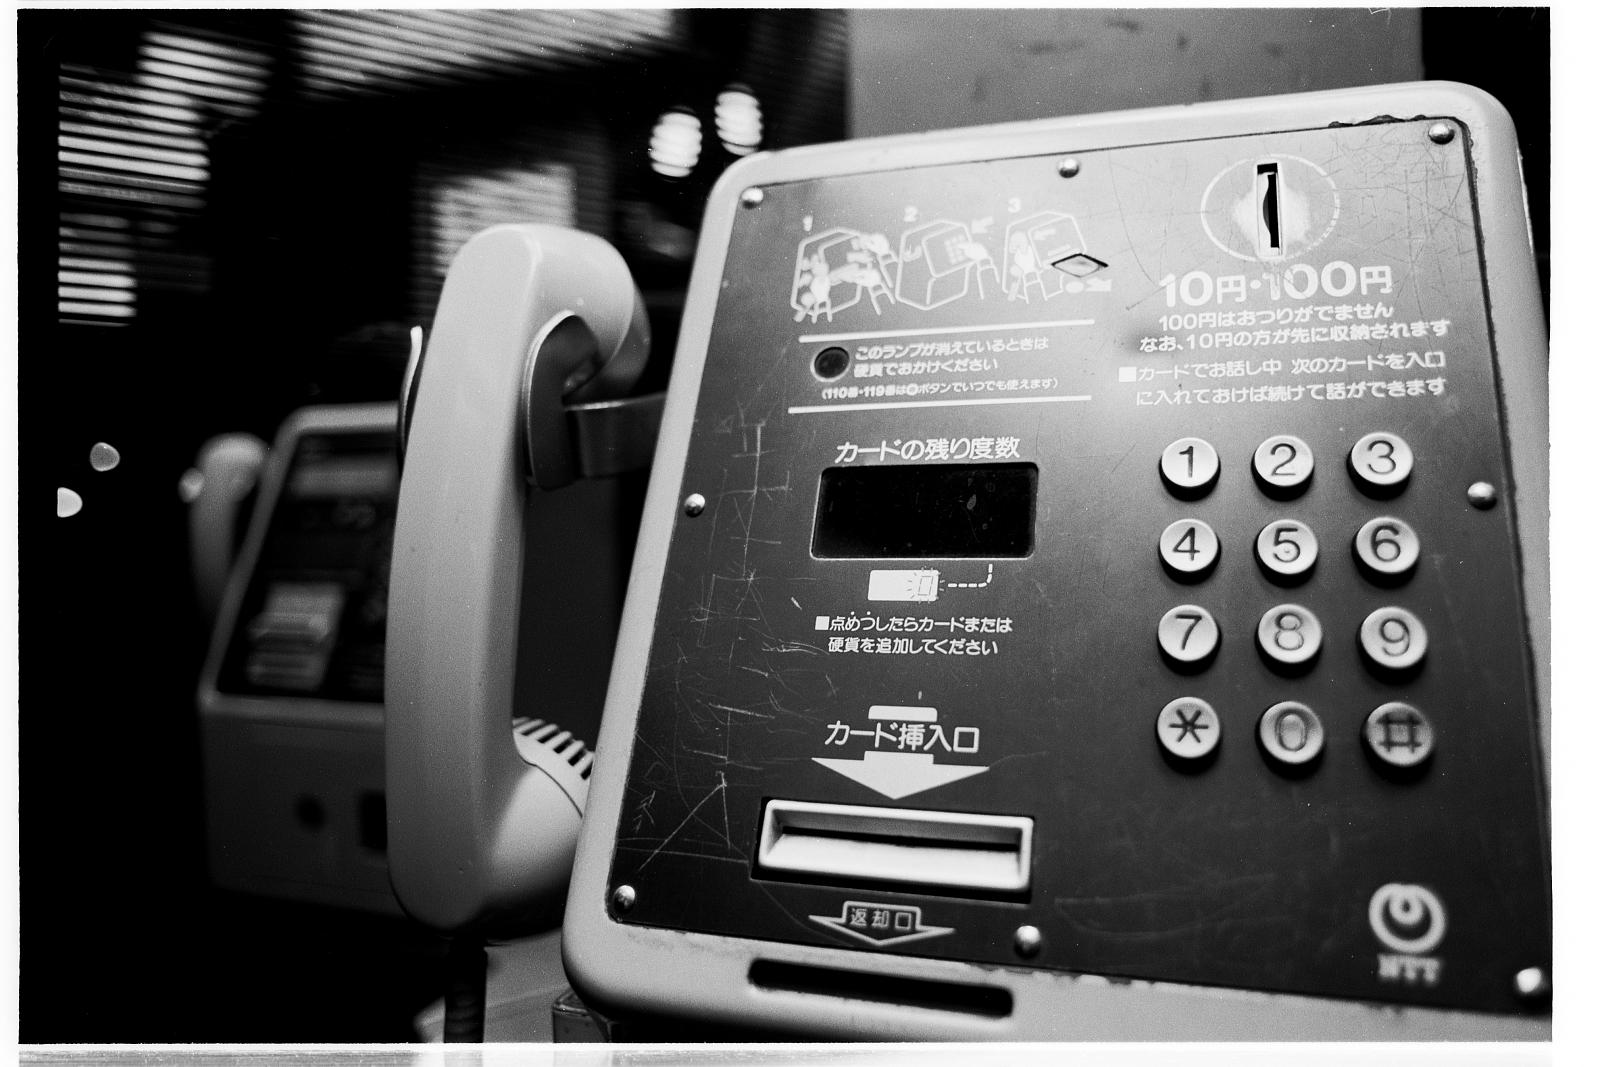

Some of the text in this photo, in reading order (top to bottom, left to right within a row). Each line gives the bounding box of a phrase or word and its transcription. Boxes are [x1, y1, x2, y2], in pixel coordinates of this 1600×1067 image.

[903, 206, 918, 221] 2
[1007, 197, 1021, 213] 3
[1159, 302, 1394, 331] 100円はおつりがでません
[1140, 319, 1451, 353] なお、10円の方が先に収納されます
[1139, 351, 1446, 382] カードでお話し中 次のカードを入口
[1136, 377, 1447, 406] に入れておけば続けて話ができます
[834, 436, 1021, 463] カードの残り度数
[1179, 440, 1397, 478] 1 2 3
[1172, 525, 1401, 563] 4 5 6
[829, 615, 1013, 634] 点めつしたらカードまたは
[1175, 611, 1411, 657] 7 8 9
[828, 636, 999, 656] 硬貨を追加してください
[824, 720, 980, 753] カード挿入口
[1274, 708, 1308, 752] 0
[850, 908, 913, 931] 返却口
